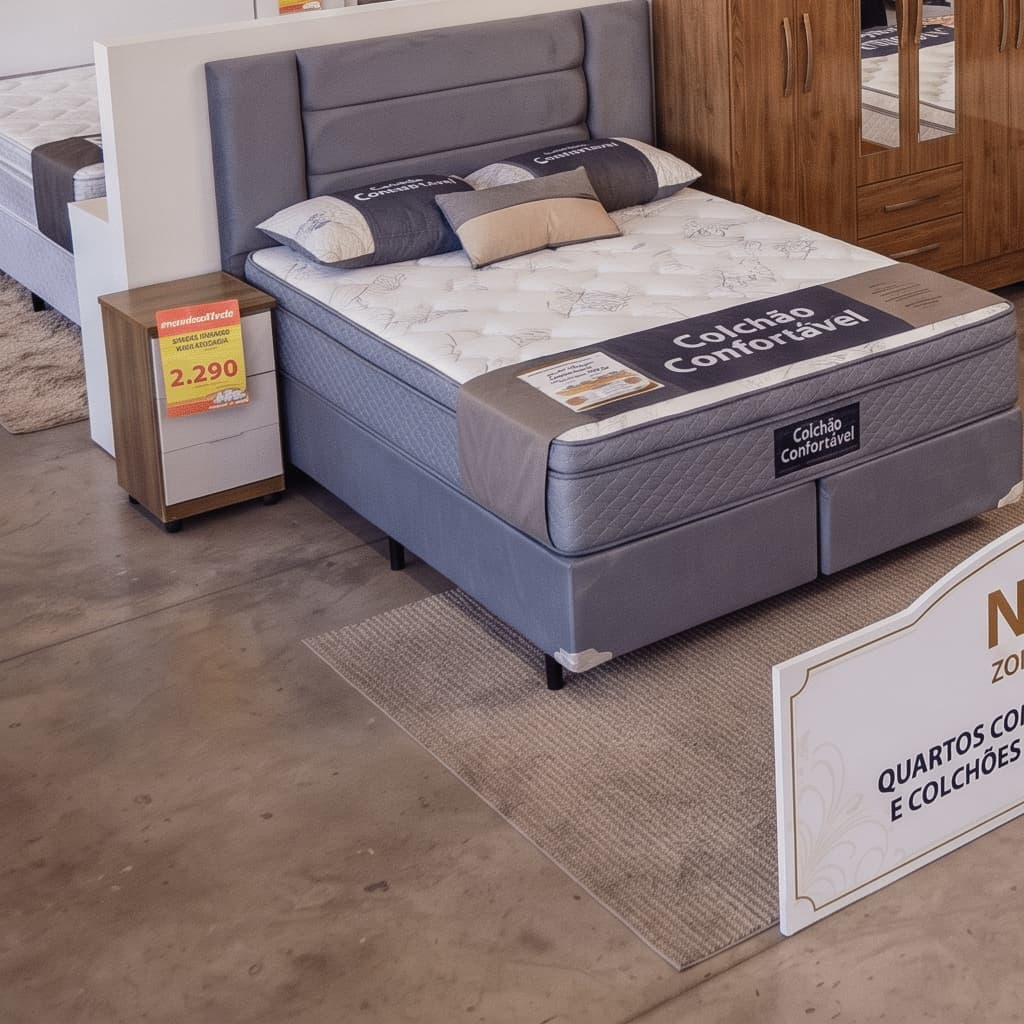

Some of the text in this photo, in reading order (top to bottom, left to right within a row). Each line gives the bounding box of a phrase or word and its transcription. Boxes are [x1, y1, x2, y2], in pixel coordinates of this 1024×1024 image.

[663, 308, 870, 373] Confortável
[672, 307, 815, 349] Colchão
[169, 359, 238, 388] 2.290
[780, 425, 855, 463] Confortável
[792, 417, 842, 443] Colchão
[878, 724, 985, 793] QUARTOS
[891, 797, 903, 822] E
[908, 739, 1021, 811] COLCHÕES
